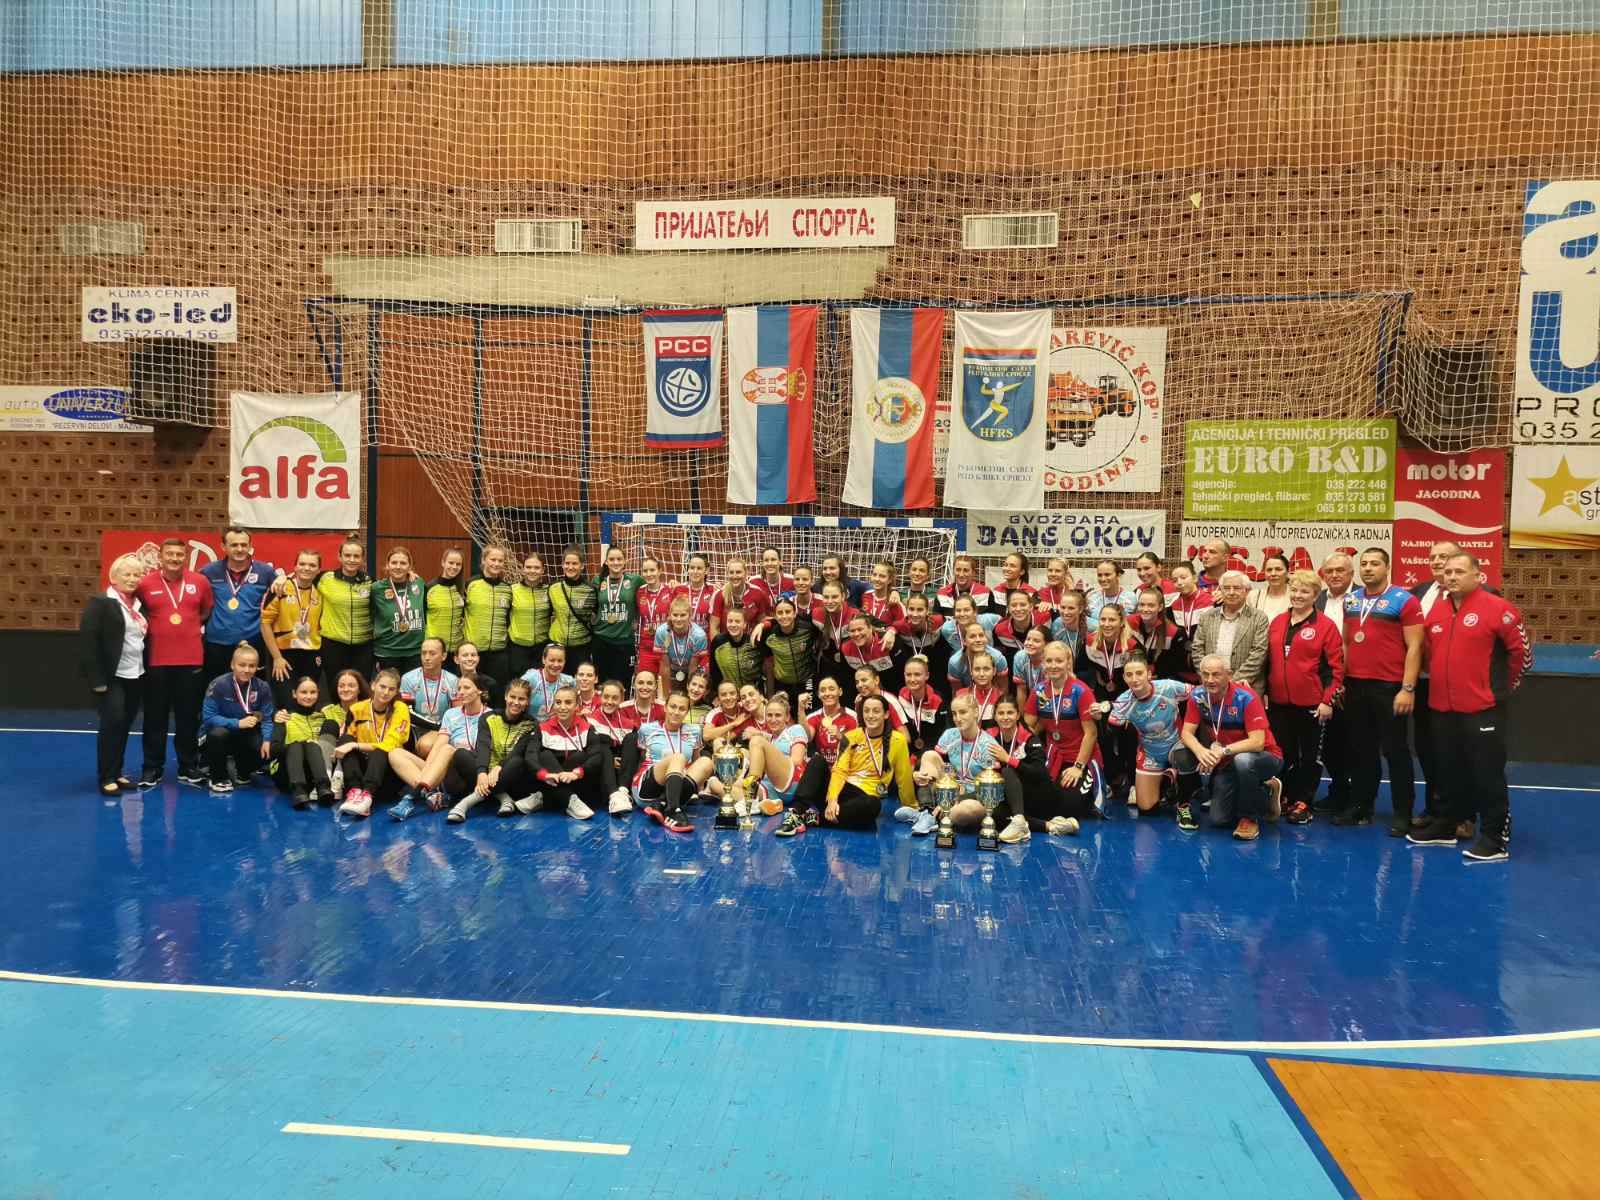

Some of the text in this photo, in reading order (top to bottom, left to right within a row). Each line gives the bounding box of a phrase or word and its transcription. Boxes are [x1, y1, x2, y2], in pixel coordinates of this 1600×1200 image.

[655, 208, 875, 239] ПРИЈАТЕЉИ СПОРТА:
[109, 289, 209, 298] KLIMA CENTAR
[1192, 428, 1255, 441] AGENCIJA
[1259, 428, 1264, 440] I
[1330, 427, 1390, 440] PREGLED
[1520, 422, 1578, 439] 035
[1193, 446, 1388, 474] EURO B&D
[239, 455, 351, 500] alfa
[1407, 460, 1493, 481] motor
[1416, 490, 1481, 500] JAGODINA
[1071, 526, 1155, 548] OKOV
[1184, 526, 1256, 538] AUTOPERIONICA
[1353, 528, 1391, 541] RADNJA
